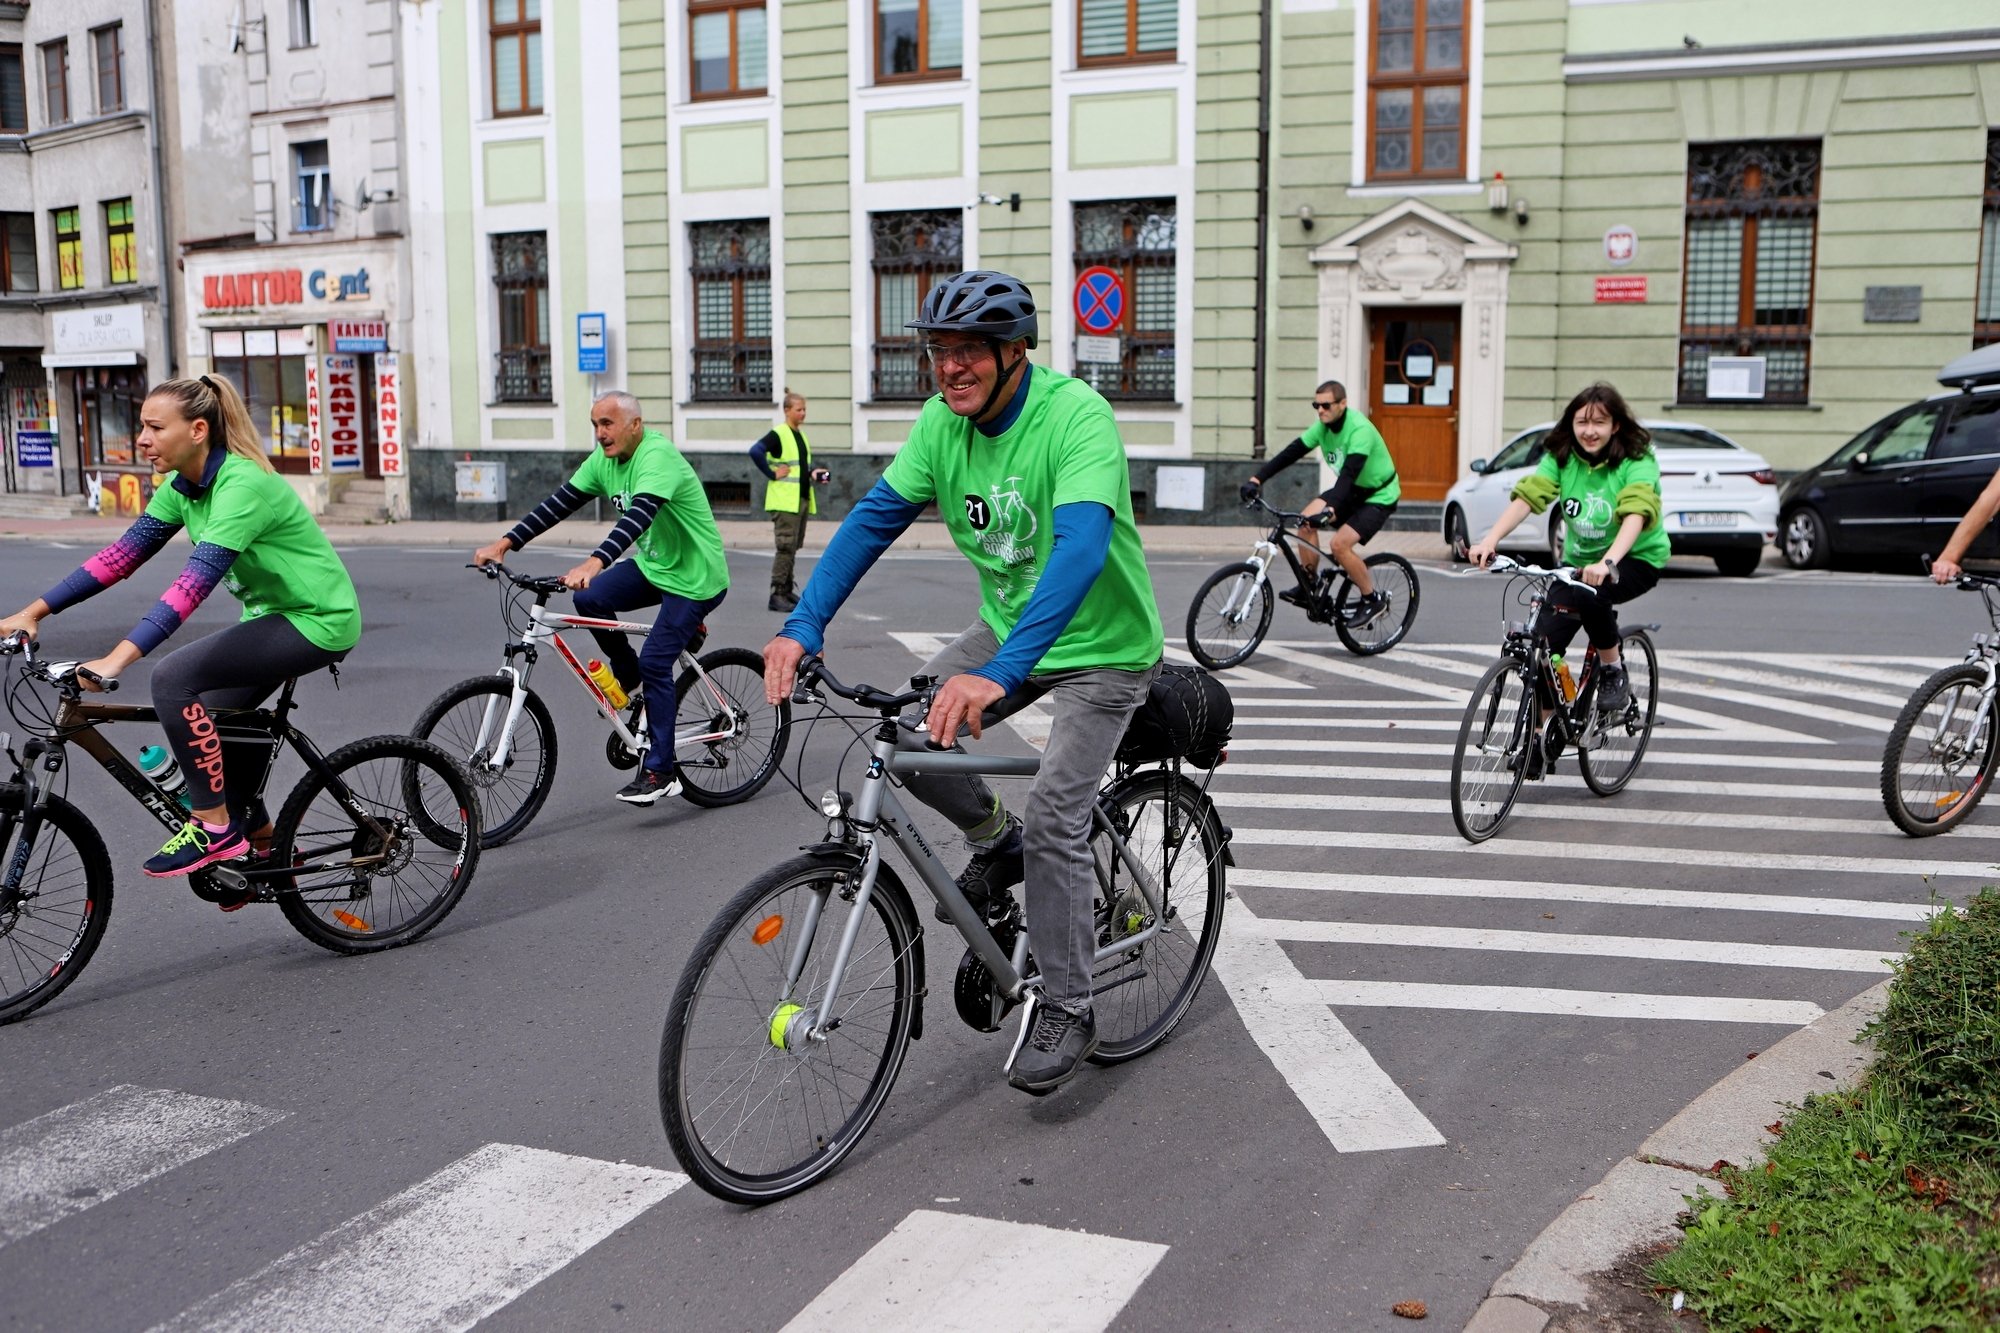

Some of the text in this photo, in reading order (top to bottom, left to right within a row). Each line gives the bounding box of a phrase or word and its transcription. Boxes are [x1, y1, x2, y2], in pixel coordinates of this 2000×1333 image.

[204, 268, 371, 309] KANTOR Cent
[337, 323, 384, 337] KANTOR
[326, 358, 354, 369] Cent
[308, 368, 320, 469] KANTOR
[329, 373, 357, 455] KANTOR
[380, 375, 399, 471] KANTOR
[612, 497, 625, 511] 21
[966, 499, 984, 525] 21
[1565, 499, 1580, 516] 21
[182, 702, 225, 793] adidas
